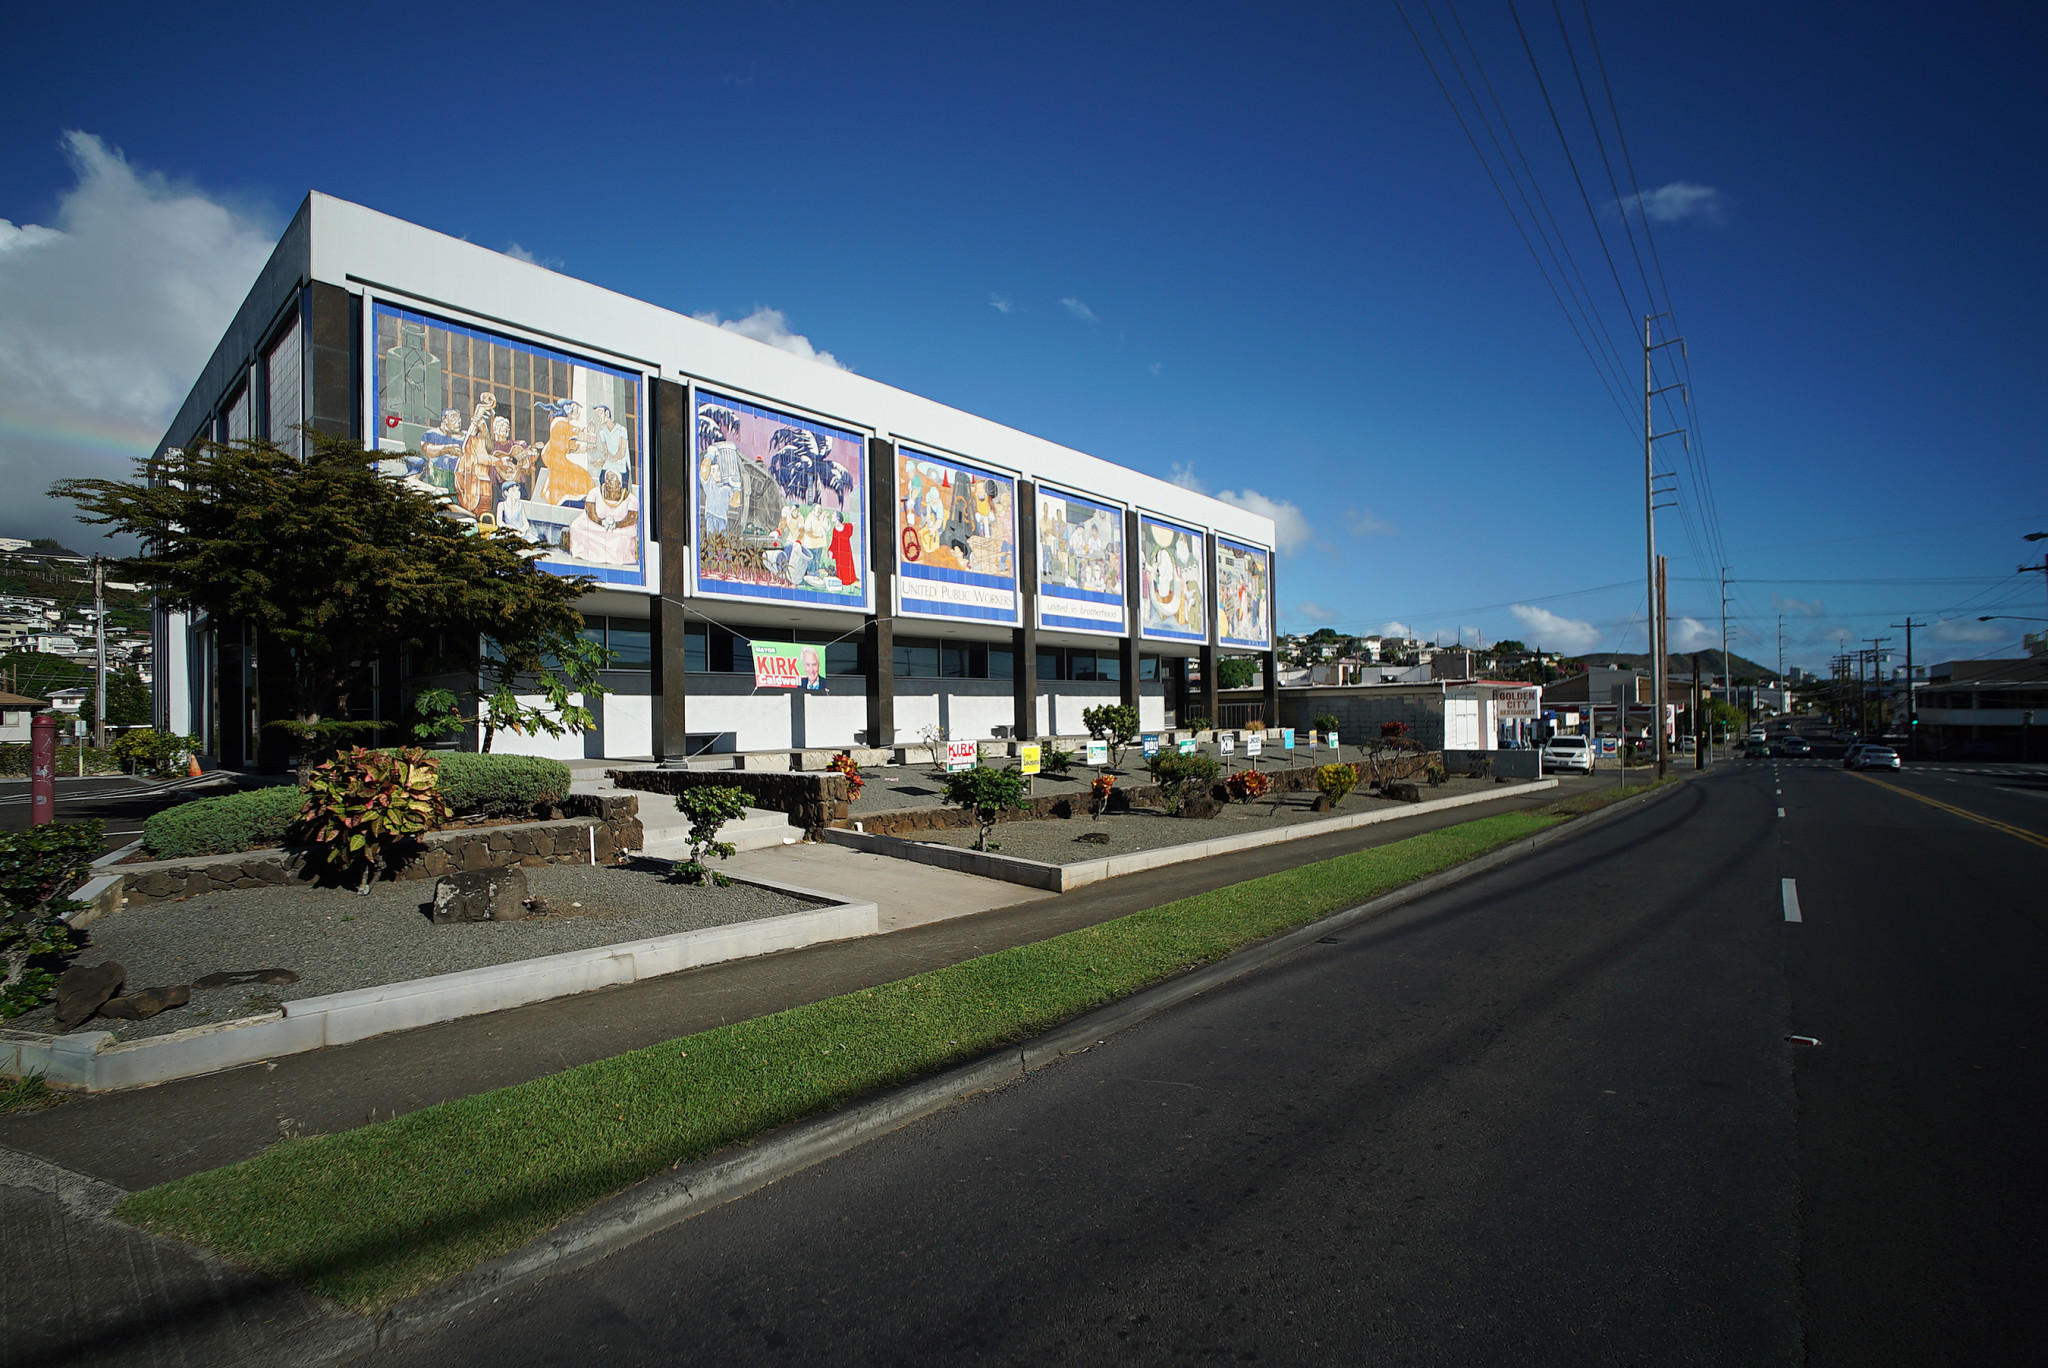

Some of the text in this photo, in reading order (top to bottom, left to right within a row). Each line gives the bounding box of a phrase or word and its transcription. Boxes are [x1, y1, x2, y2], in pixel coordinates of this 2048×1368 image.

[901, 580, 1013, 607] UNITED PUBLIC WORKERS
[1047, 602, 1069, 613] united
[1080, 604, 1117, 618] brotherhood
[756, 655, 800, 676] KIRK
[758, 674, 802, 686] Caldwell
[1499, 691, 1535, 700] GOLDEN
[1506, 700, 1528, 709] CITY
[948, 742, 976, 756] KIRK
